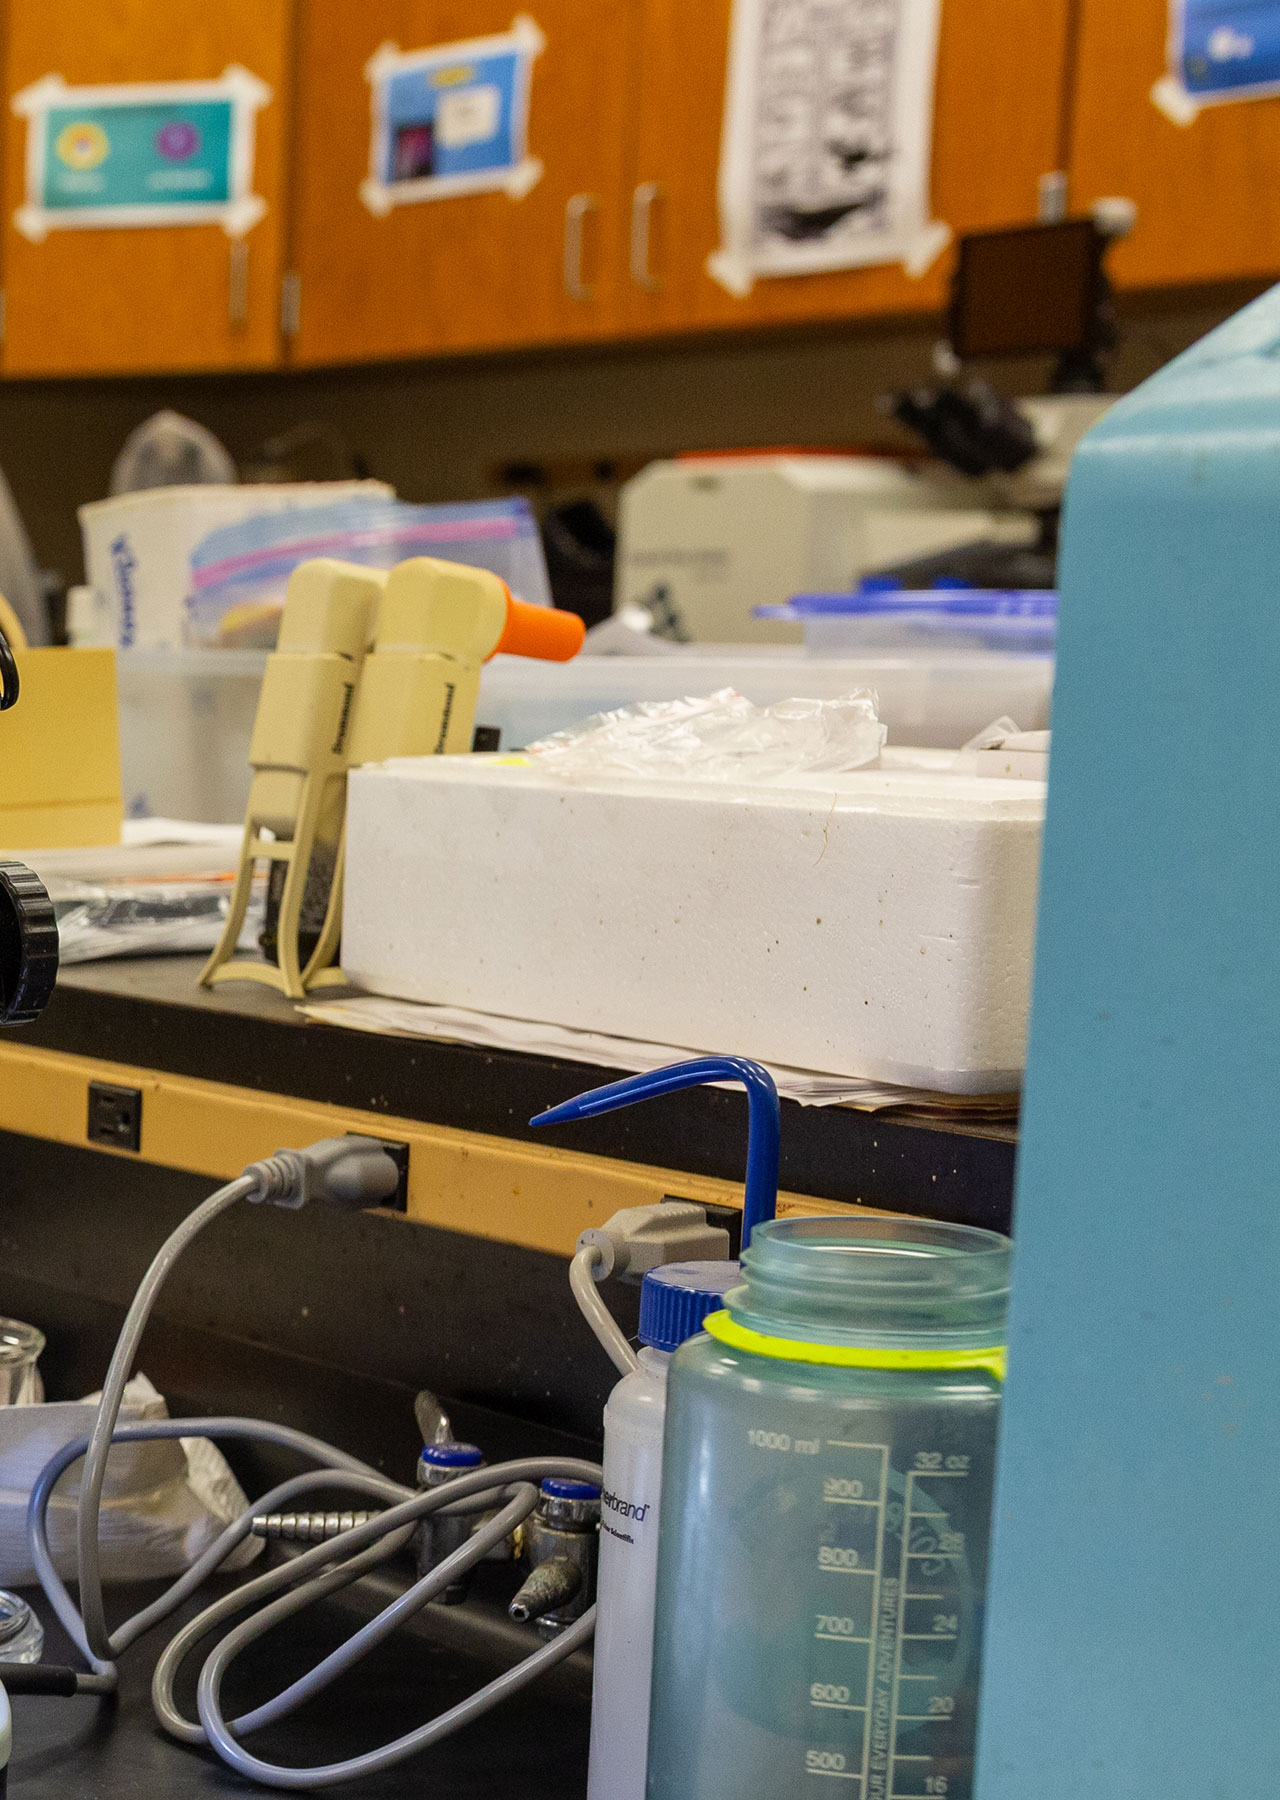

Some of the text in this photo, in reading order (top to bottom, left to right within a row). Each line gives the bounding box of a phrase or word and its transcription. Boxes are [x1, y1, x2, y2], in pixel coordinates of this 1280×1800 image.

[748, 1430, 820, 1455] 1000 ml
[914, 1451, 971, 1469] 32 oz
[823, 1477, 863, 1498] 900
[818, 1546, 858, 1566] 800
[816, 1614, 854, 1634] 700
[875, 1578, 899, 1683] ADVENTURES
[932, 1614, 957, 1632] 24
[810, 1683, 850, 1703] 600
[928, 1696, 954, 1714] 20
[871, 1687, 890, 1770] EVERYDAY
[806, 1750, 845, 1771] 500
[925, 1776, 948, 1793] 16
